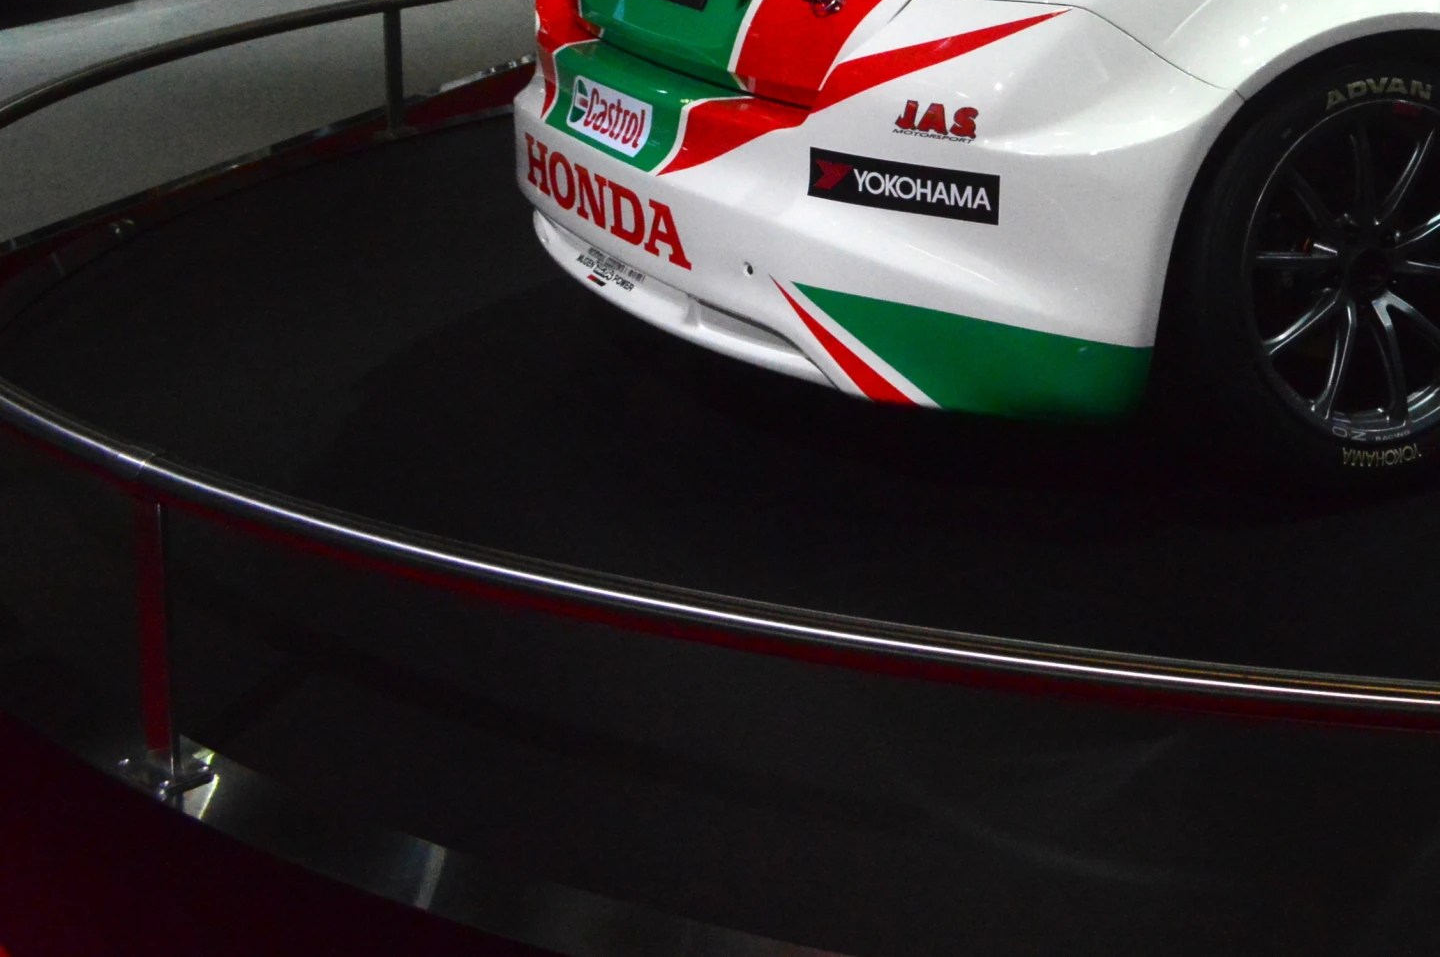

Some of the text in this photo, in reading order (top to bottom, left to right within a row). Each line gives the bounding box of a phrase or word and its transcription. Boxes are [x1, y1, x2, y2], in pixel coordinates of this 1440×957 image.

[1325, 76, 1433, 111] ADVAN
[583, 87, 647, 149] Castrol
[892, 128, 976, 144] MOTORSPORT
[894, 99, 980, 139] JAS
[524, 131, 693, 271] HONDA
[853, 167, 992, 212] YOKOHAMA
[1341, 443, 1423, 468] YOKOHAMA
